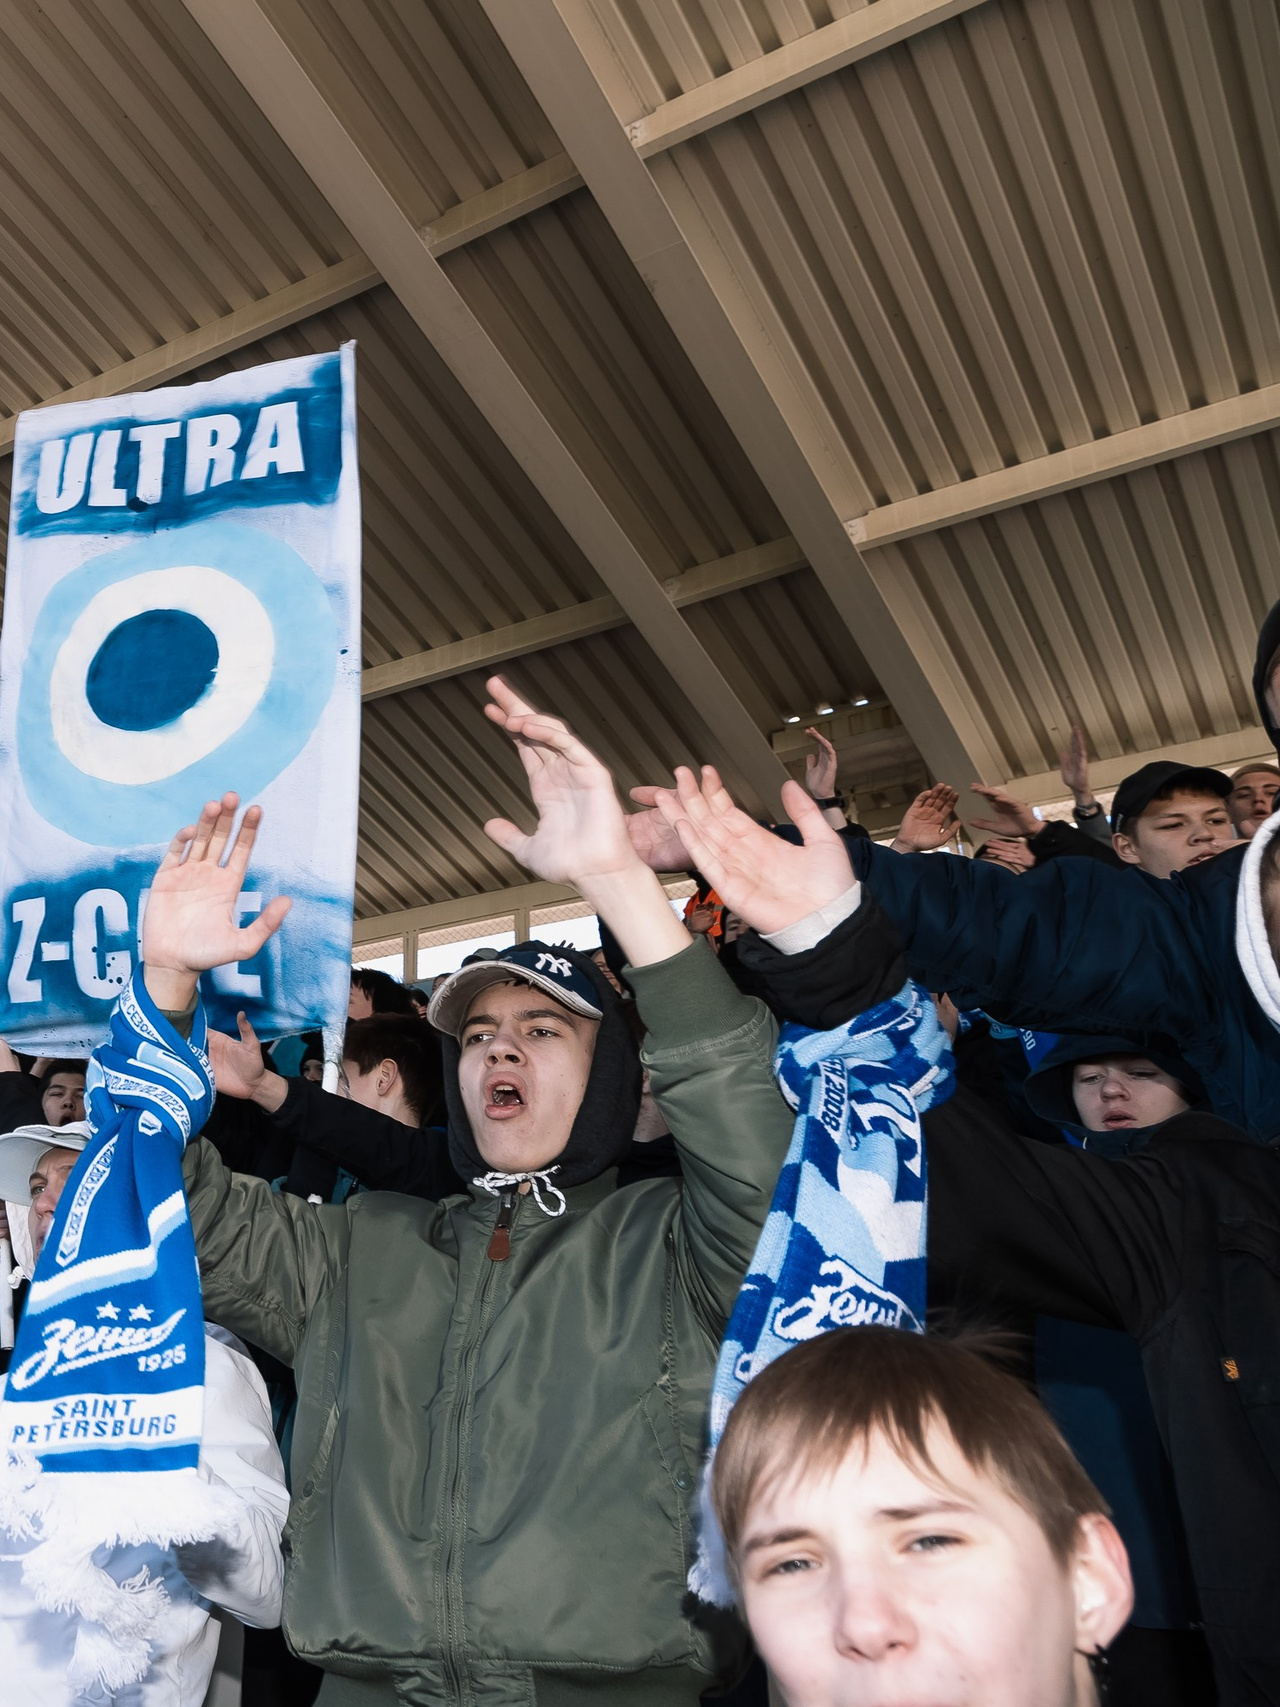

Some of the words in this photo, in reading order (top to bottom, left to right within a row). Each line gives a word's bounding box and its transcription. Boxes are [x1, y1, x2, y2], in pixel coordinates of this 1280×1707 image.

[35, 401, 306, 515] ULTRA
[534, 952, 573, 978] NY
[820, 1081, 845, 1132] 2008
[137, 1343, 187, 1372] 1925
[51, 1398, 138, 1420] SAINT
[11, 1413, 178, 1444] PETERSBURG
